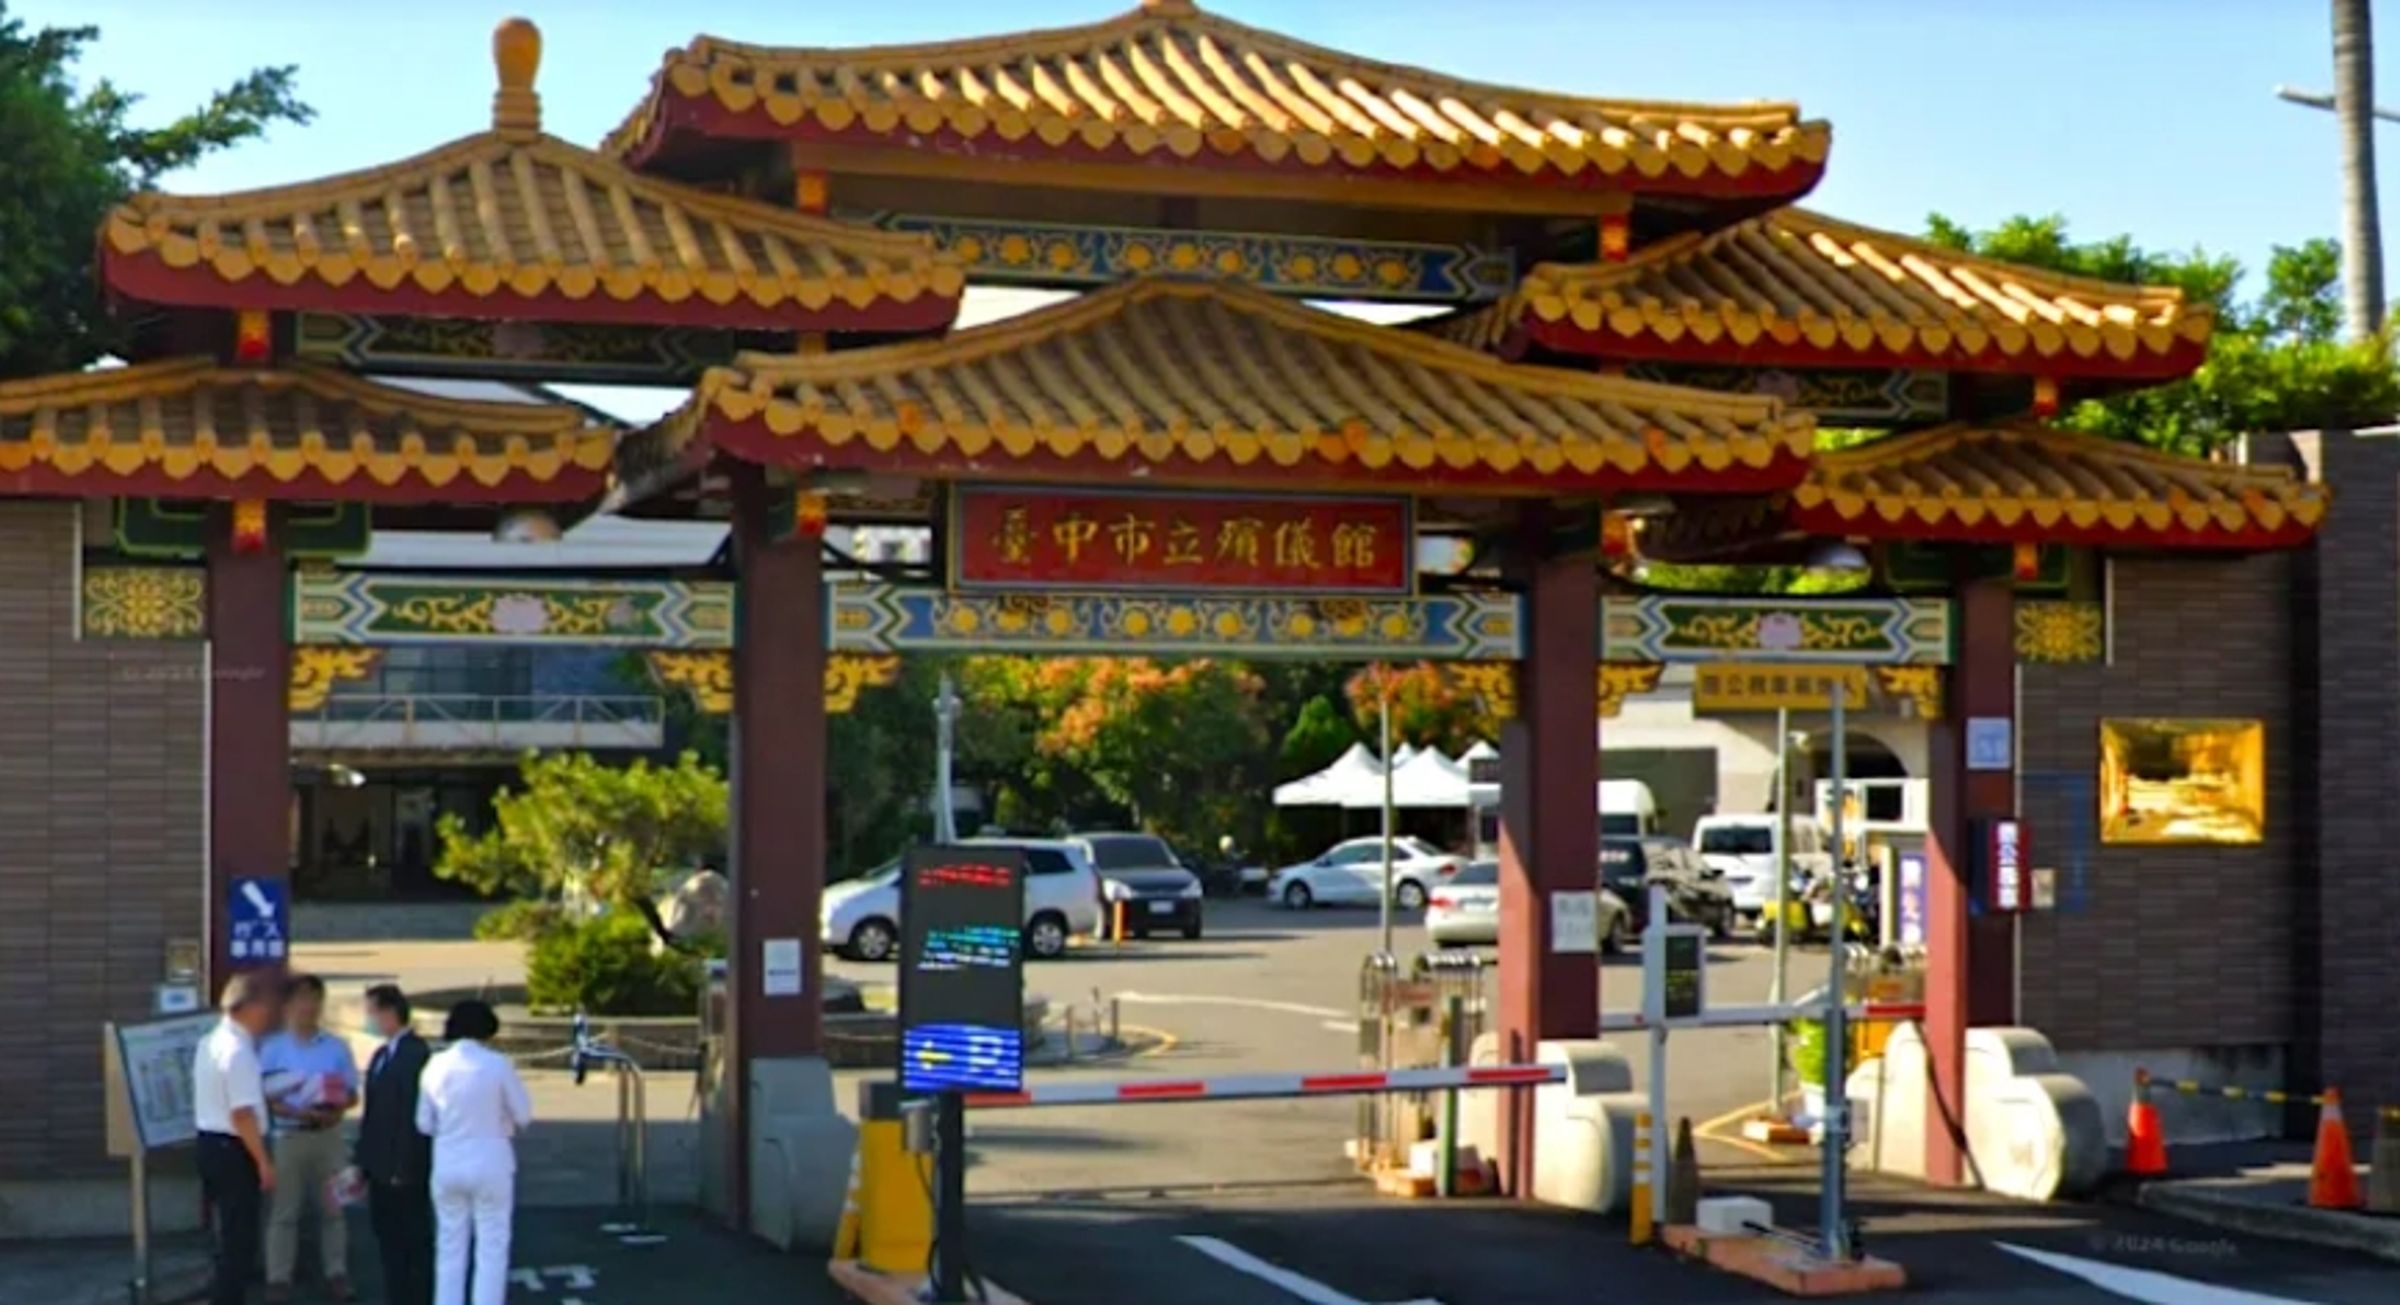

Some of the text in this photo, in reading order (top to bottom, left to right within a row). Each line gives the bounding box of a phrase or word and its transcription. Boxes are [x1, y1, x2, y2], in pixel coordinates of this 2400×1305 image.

[992, 508, 1379, 570] 臺中市立殯儀館
